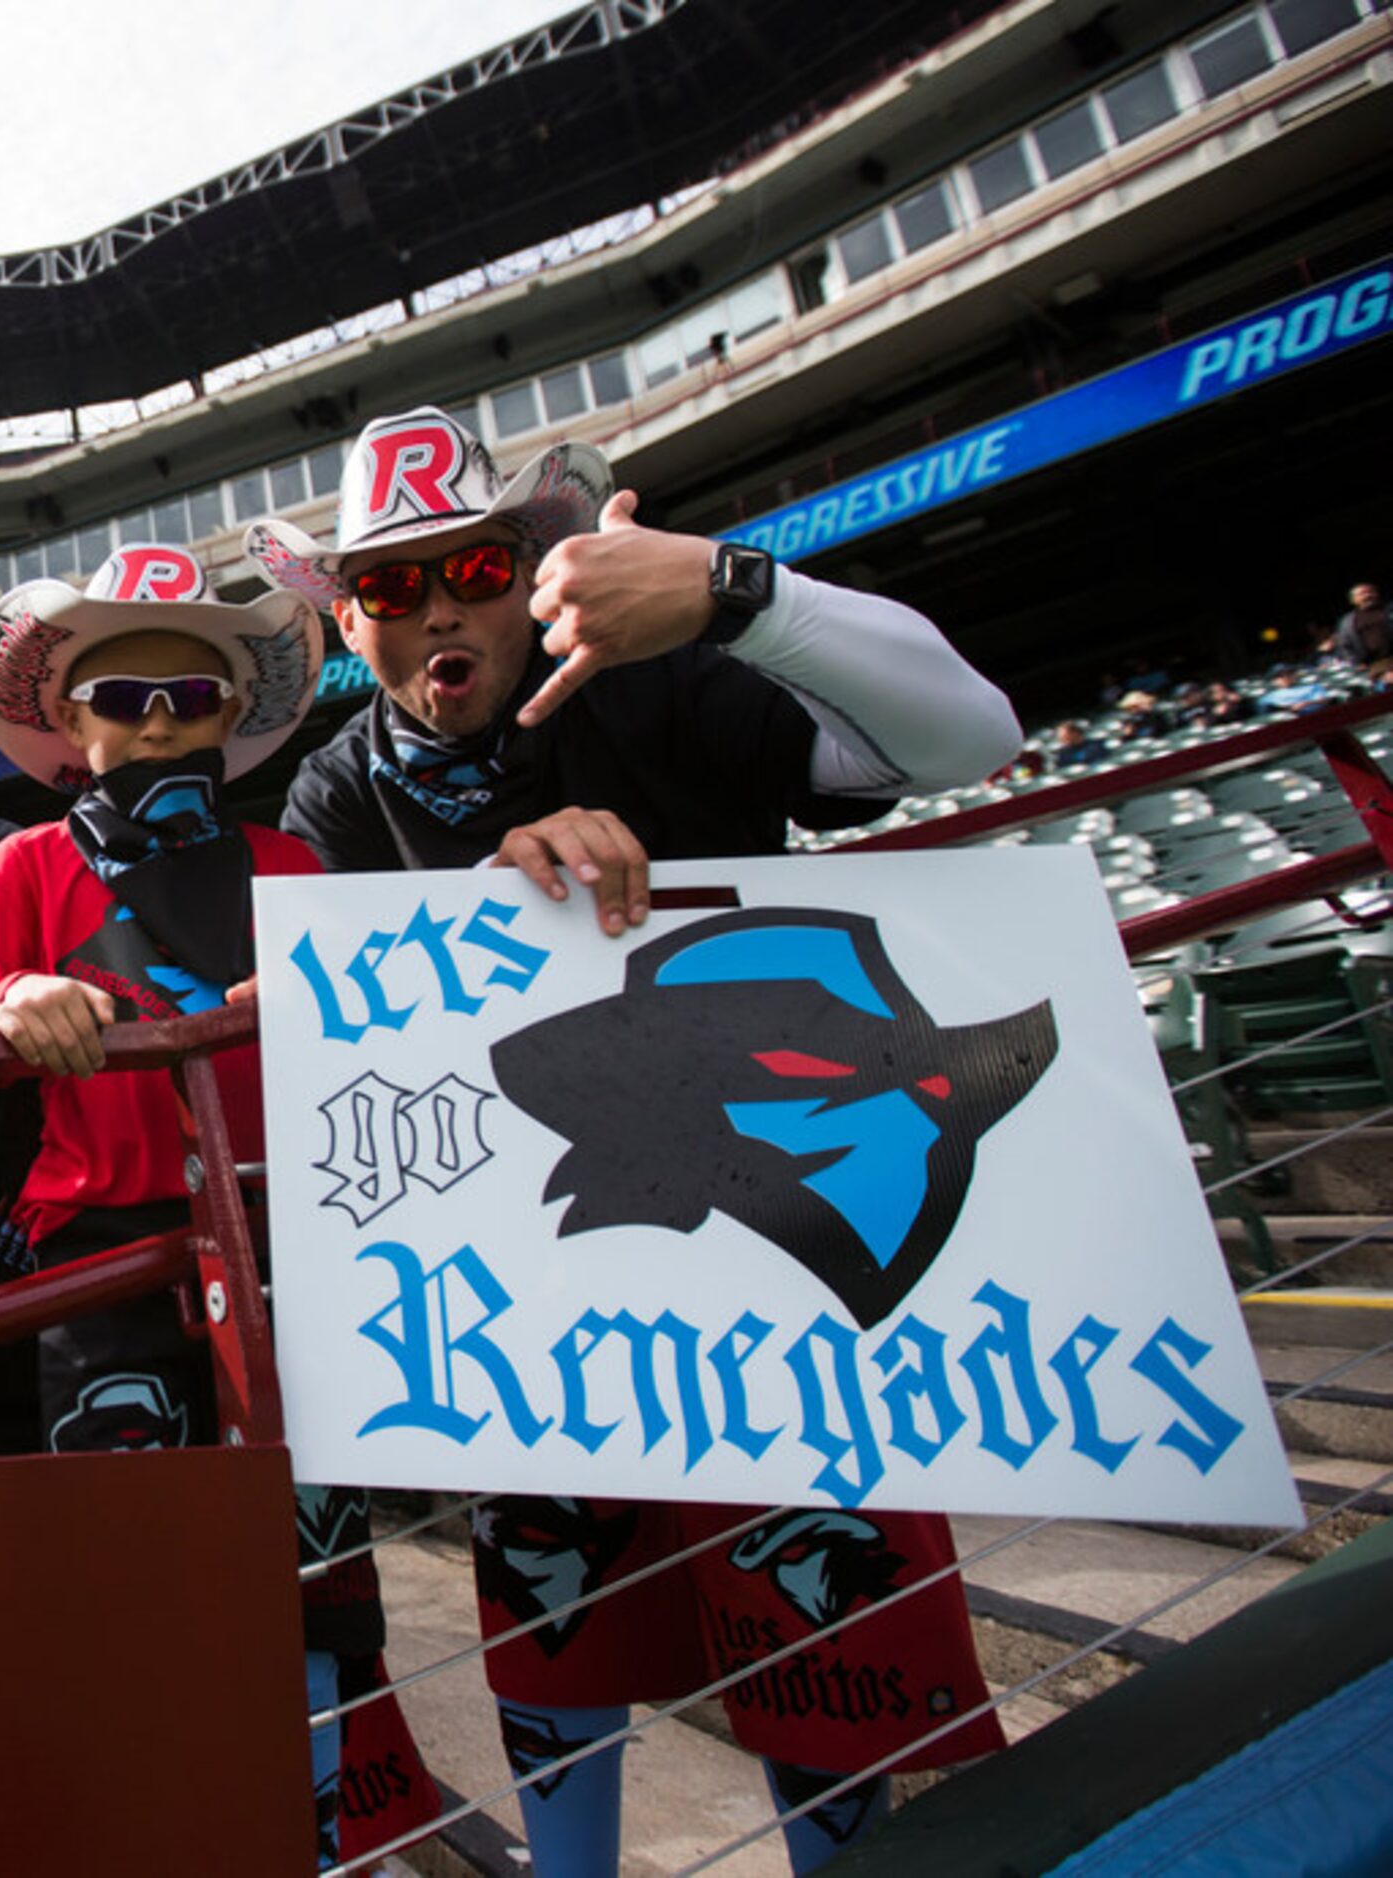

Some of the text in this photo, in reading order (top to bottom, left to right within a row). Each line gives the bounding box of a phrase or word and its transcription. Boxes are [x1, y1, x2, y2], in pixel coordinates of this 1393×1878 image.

[1177, 271, 1393, 402] PROG
[364, 420, 466, 517] R
[311, 1069, 498, 1229] go
[356, 1242, 1245, 1508] Renegades
